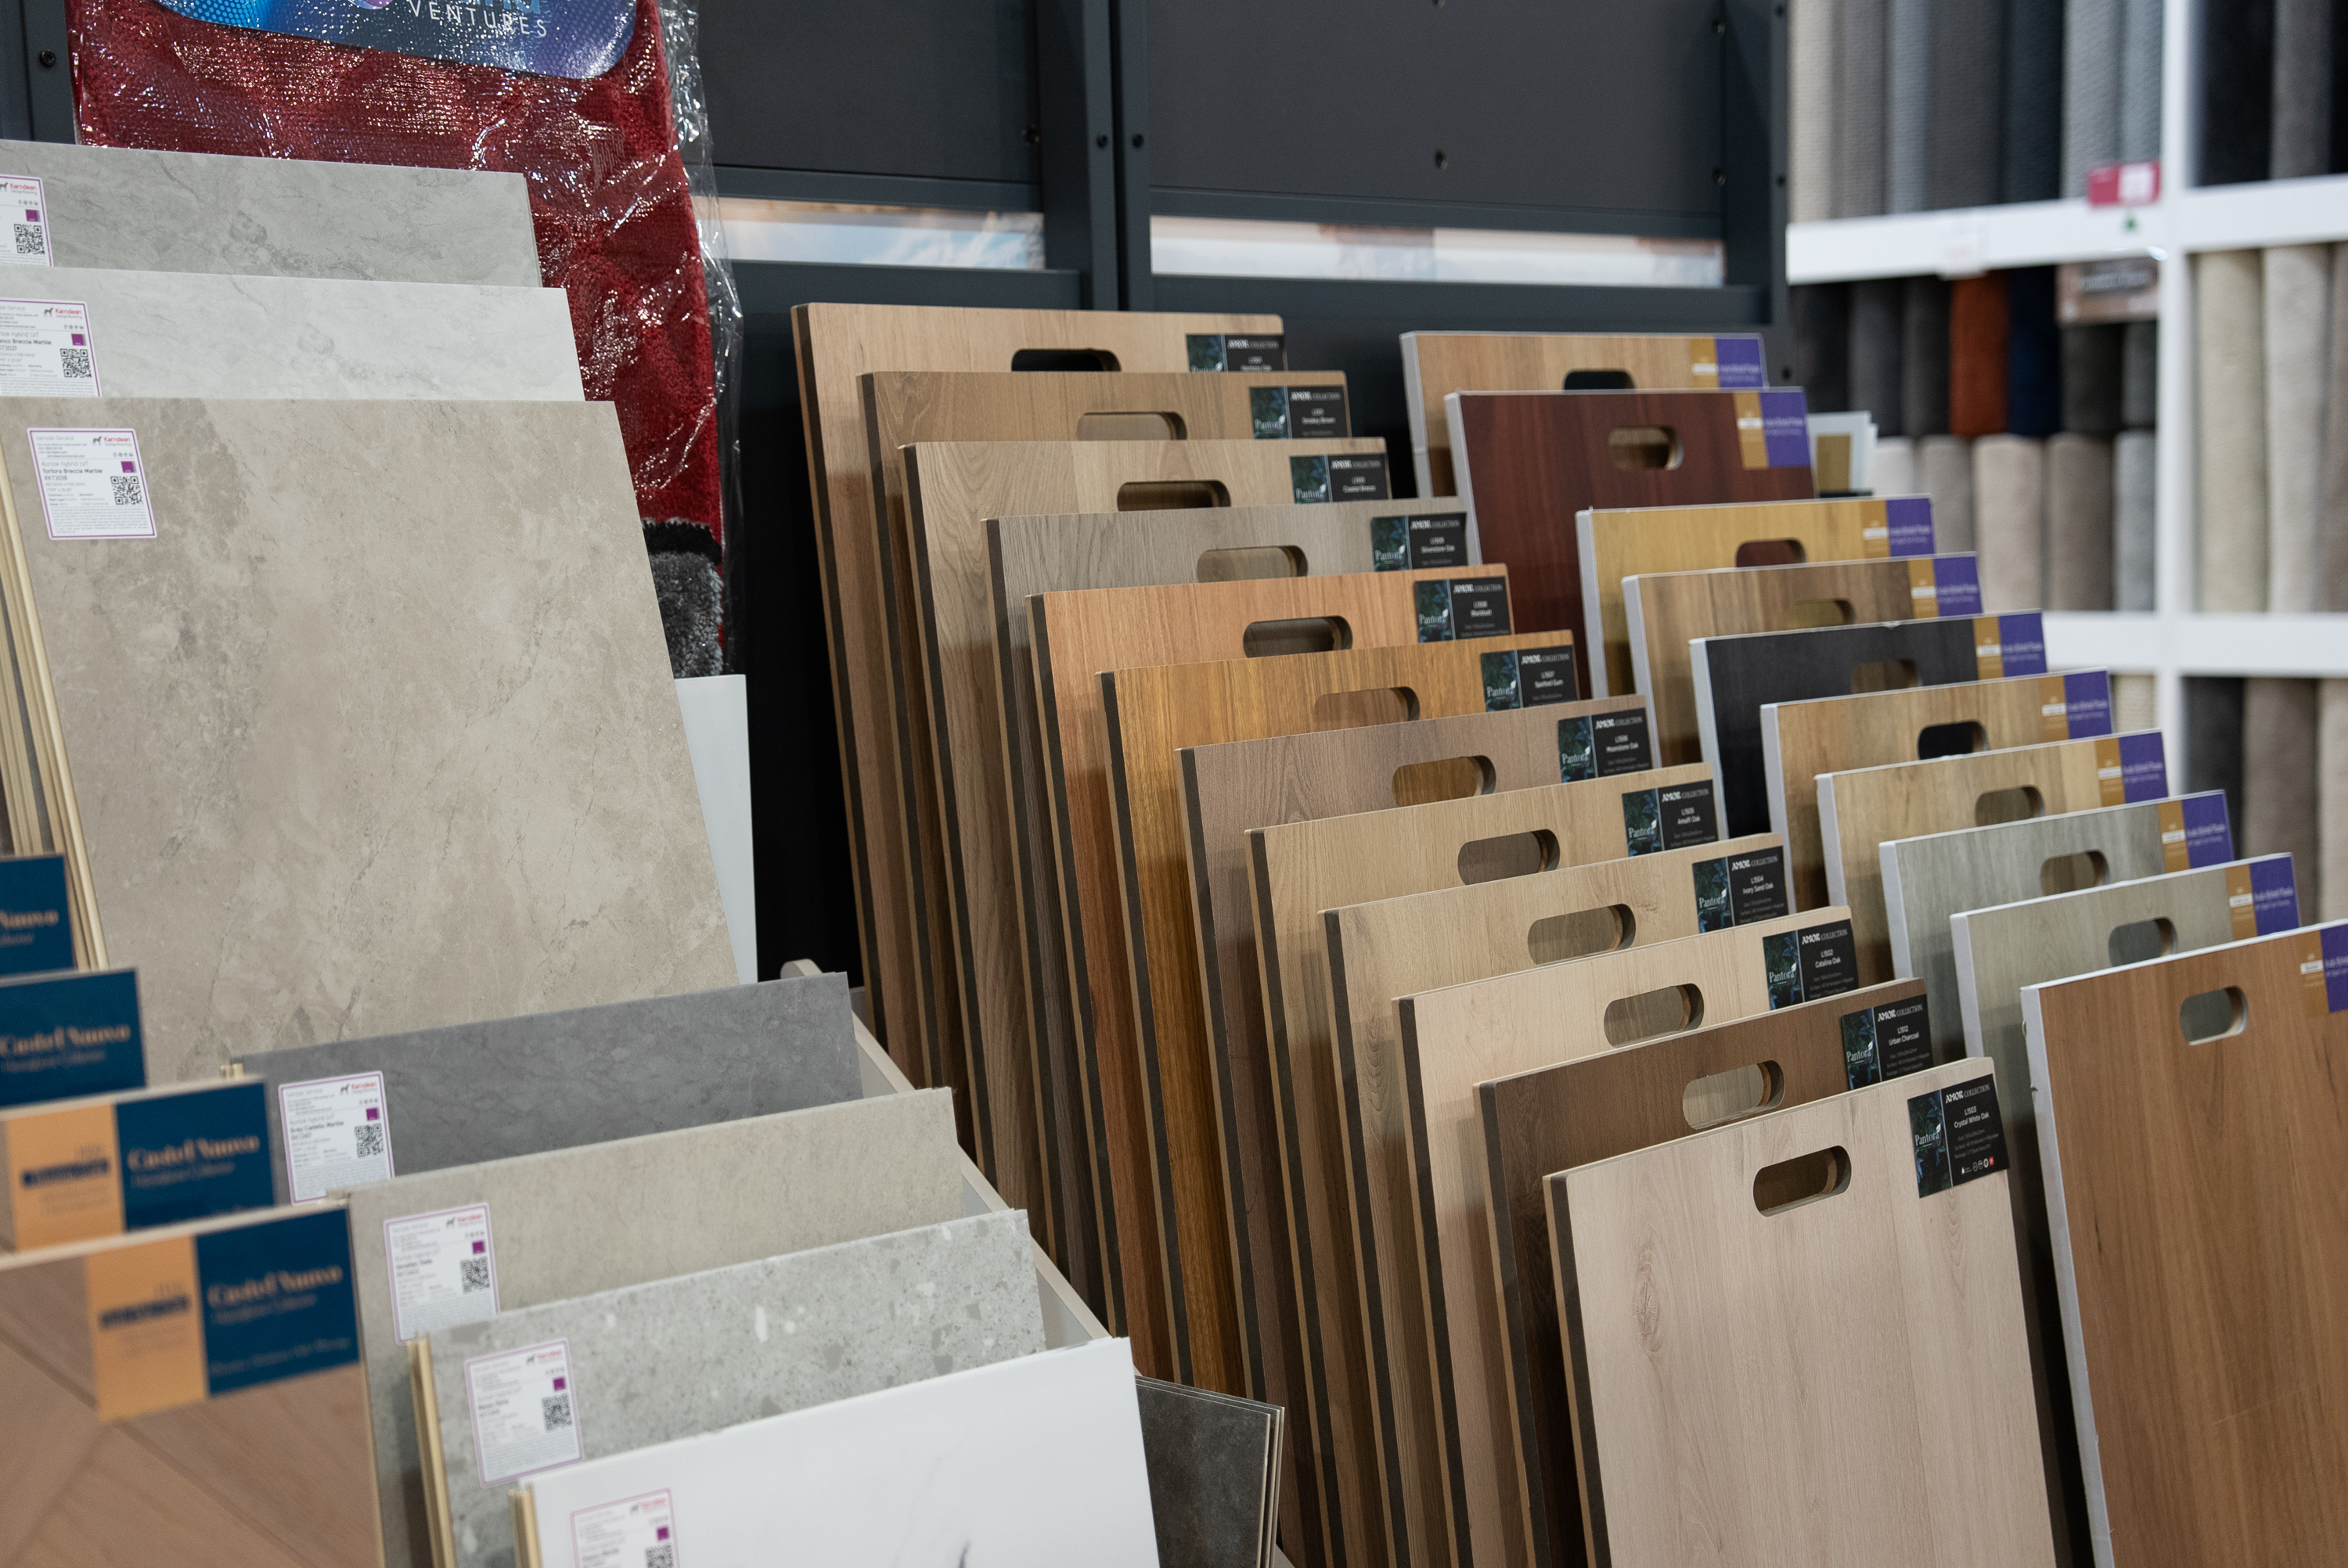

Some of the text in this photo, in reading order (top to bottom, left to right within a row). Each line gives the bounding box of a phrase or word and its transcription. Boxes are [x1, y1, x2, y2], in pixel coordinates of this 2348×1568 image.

[409, 0, 547, 38] VENTURES
[1374, 549, 1403, 562] Pantora
[1453, 583, 1503, 594] AMOR COLLECTION
[1419, 613, 1447, 625] Pantora
[1521, 653, 1570, 665] AMOR COLLECTION
[1534, 678, 1564, 689] Spotted Gum
[1486, 685, 1514, 698] Pantora
[1595, 716, 1643, 730] AMOR COLLECTION
[1630, 742, 1639, 750] Oak
[1561, 753, 1589, 765] Pantora
[1662, 788, 1709, 803] AMOR COLLECTION
[1628, 826, 1655, 839] Pantora
[1731, 854, 1778, 871] AMOR COLLECTION
[1742, 882, 1774, 895] Ivory Sand Oak
[1698, 896, 1725, 908] Pantora
[1802, 928, 1848, 945] AMOR COLLECTION
[1815, 955, 1842, 969] Catalina Oak
[1769, 969, 1795, 984] Pantora
[1878, 1003, 1924, 1023] AMOR COLLECTION
[1897, 1025, 1909, 1034] L1512
[1889, 1031, 1920, 1046] Urban Charcoal
[1846, 1048, 1872, 1063] Pantora
[1945, 1083, 1990, 1104] AMOR COLLECTION
[1964, 1105, 1977, 1117] L1503
[1954, 1111, 1990, 1128] Crystal White Oak
[1914, 1131, 1940, 1147] Pantora
